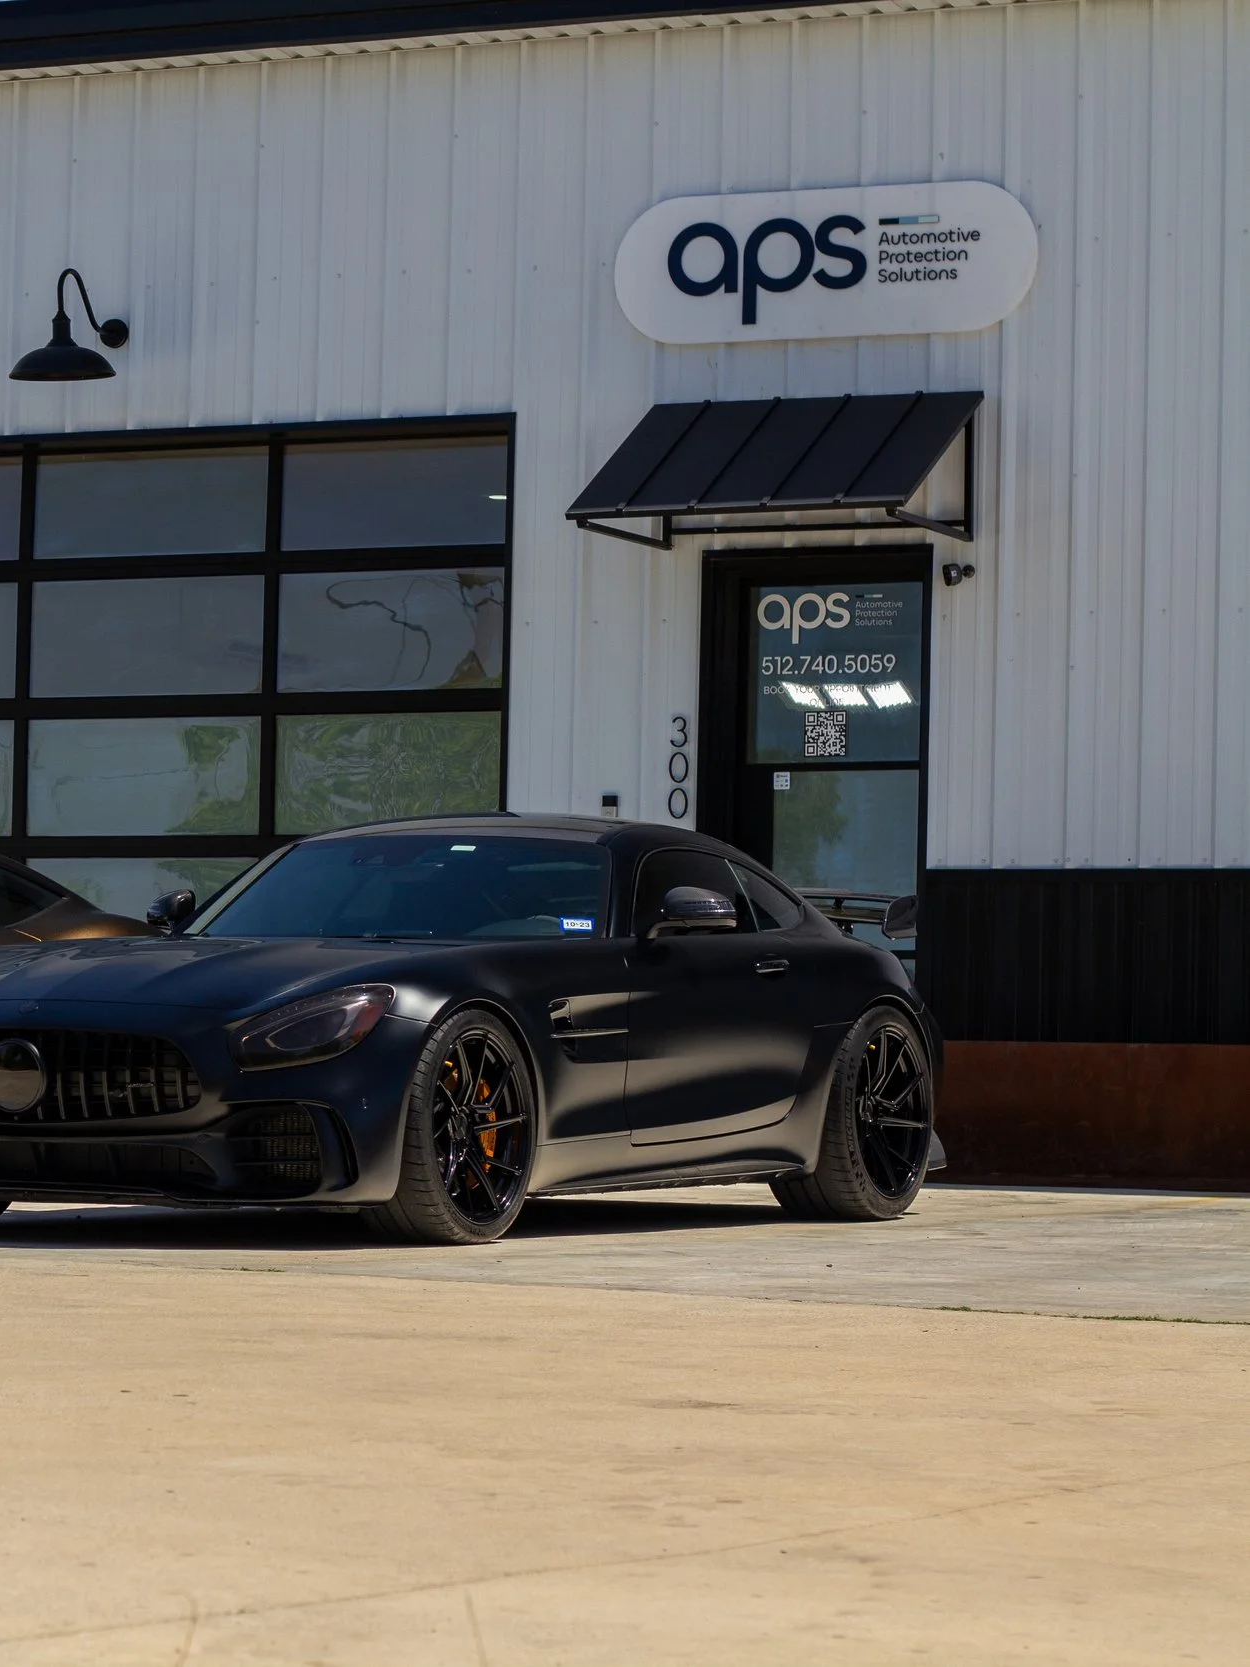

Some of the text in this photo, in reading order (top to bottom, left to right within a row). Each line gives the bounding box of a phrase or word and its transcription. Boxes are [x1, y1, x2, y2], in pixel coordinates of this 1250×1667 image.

[878, 227, 981, 246] Automotive
[878, 246, 969, 264] Protection
[668, 214, 868, 325] aps
[877, 266, 958, 283] Solutions
[855, 600, 903, 609] Automotive
[855, 609, 898, 617] Protection
[757, 592, 851, 644] aps
[855, 618, 893, 626] Solutions
[761, 654, 896, 675] 512.740.5059
[668, 716, 689, 819] 300
